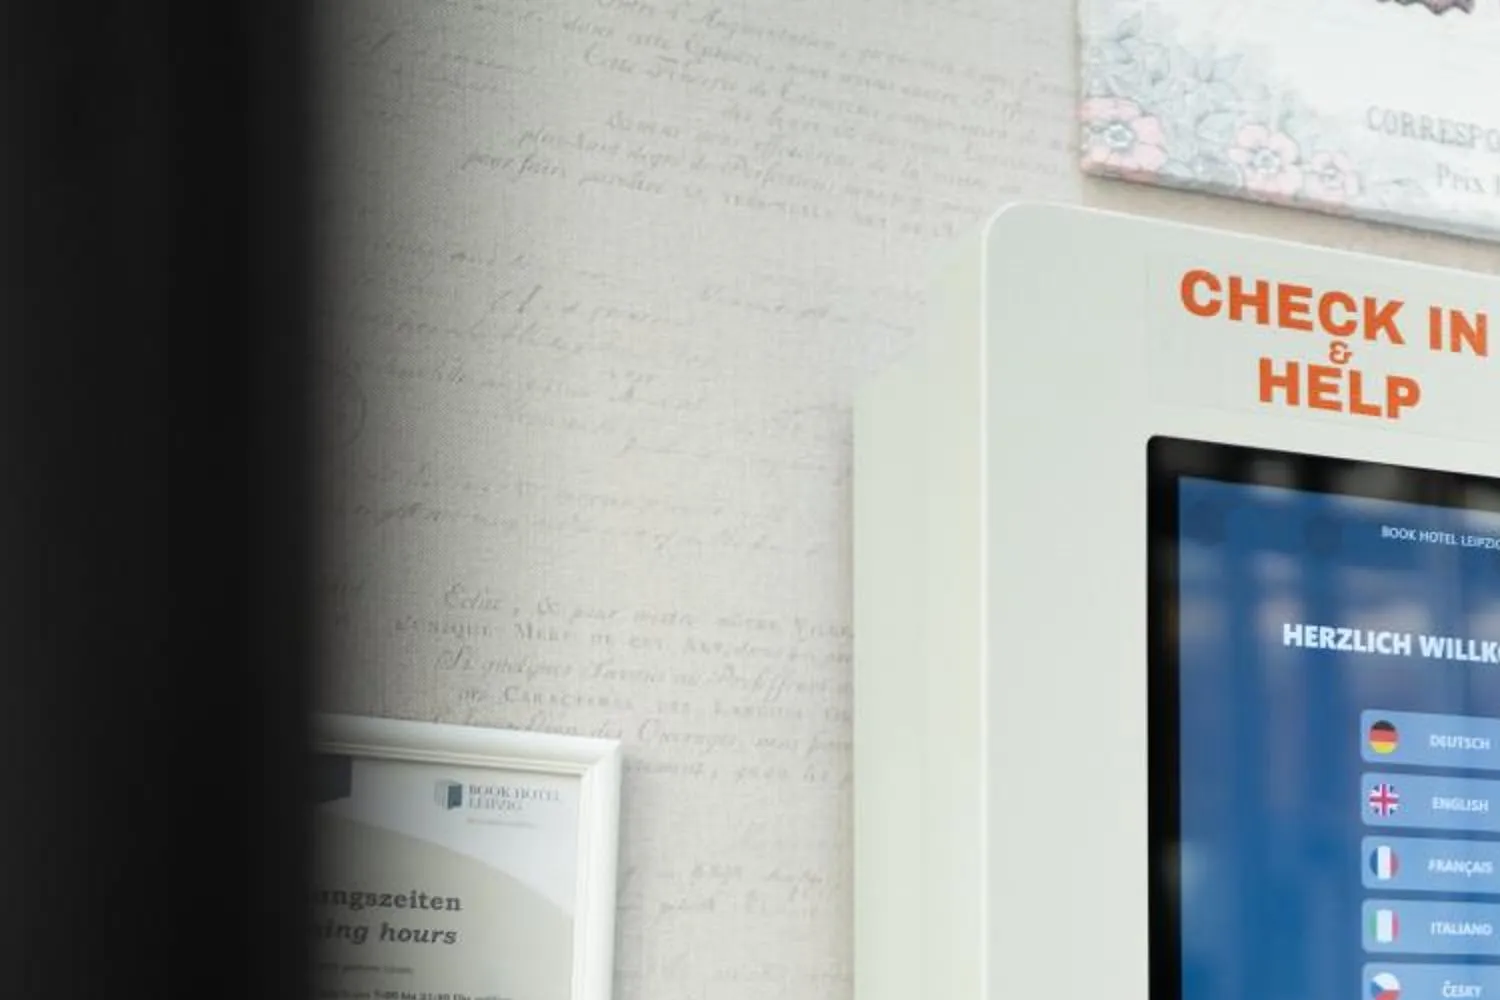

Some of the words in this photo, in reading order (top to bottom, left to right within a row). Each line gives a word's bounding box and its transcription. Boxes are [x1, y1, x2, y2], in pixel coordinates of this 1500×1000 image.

[1180, 269, 1406, 345] CHECK
[1429, 305, 1489, 357] IN
[1329, 340, 1353, 365] &
[1259, 357, 1422, 419] HELP
[1381, 525, 1417, 541] BOOK
[1419, 530, 1459, 546] HOTEL
[1282, 622, 1412, 656] HERZLICH
[1430, 733, 1491, 751] DEUTSCH
[1432, 796, 1489, 812] ENGLISH
[1428, 858, 1494, 878] FRANÇAIS
[379, 921, 458, 945] hours
[1431, 920, 1494, 936] ITALIANO
